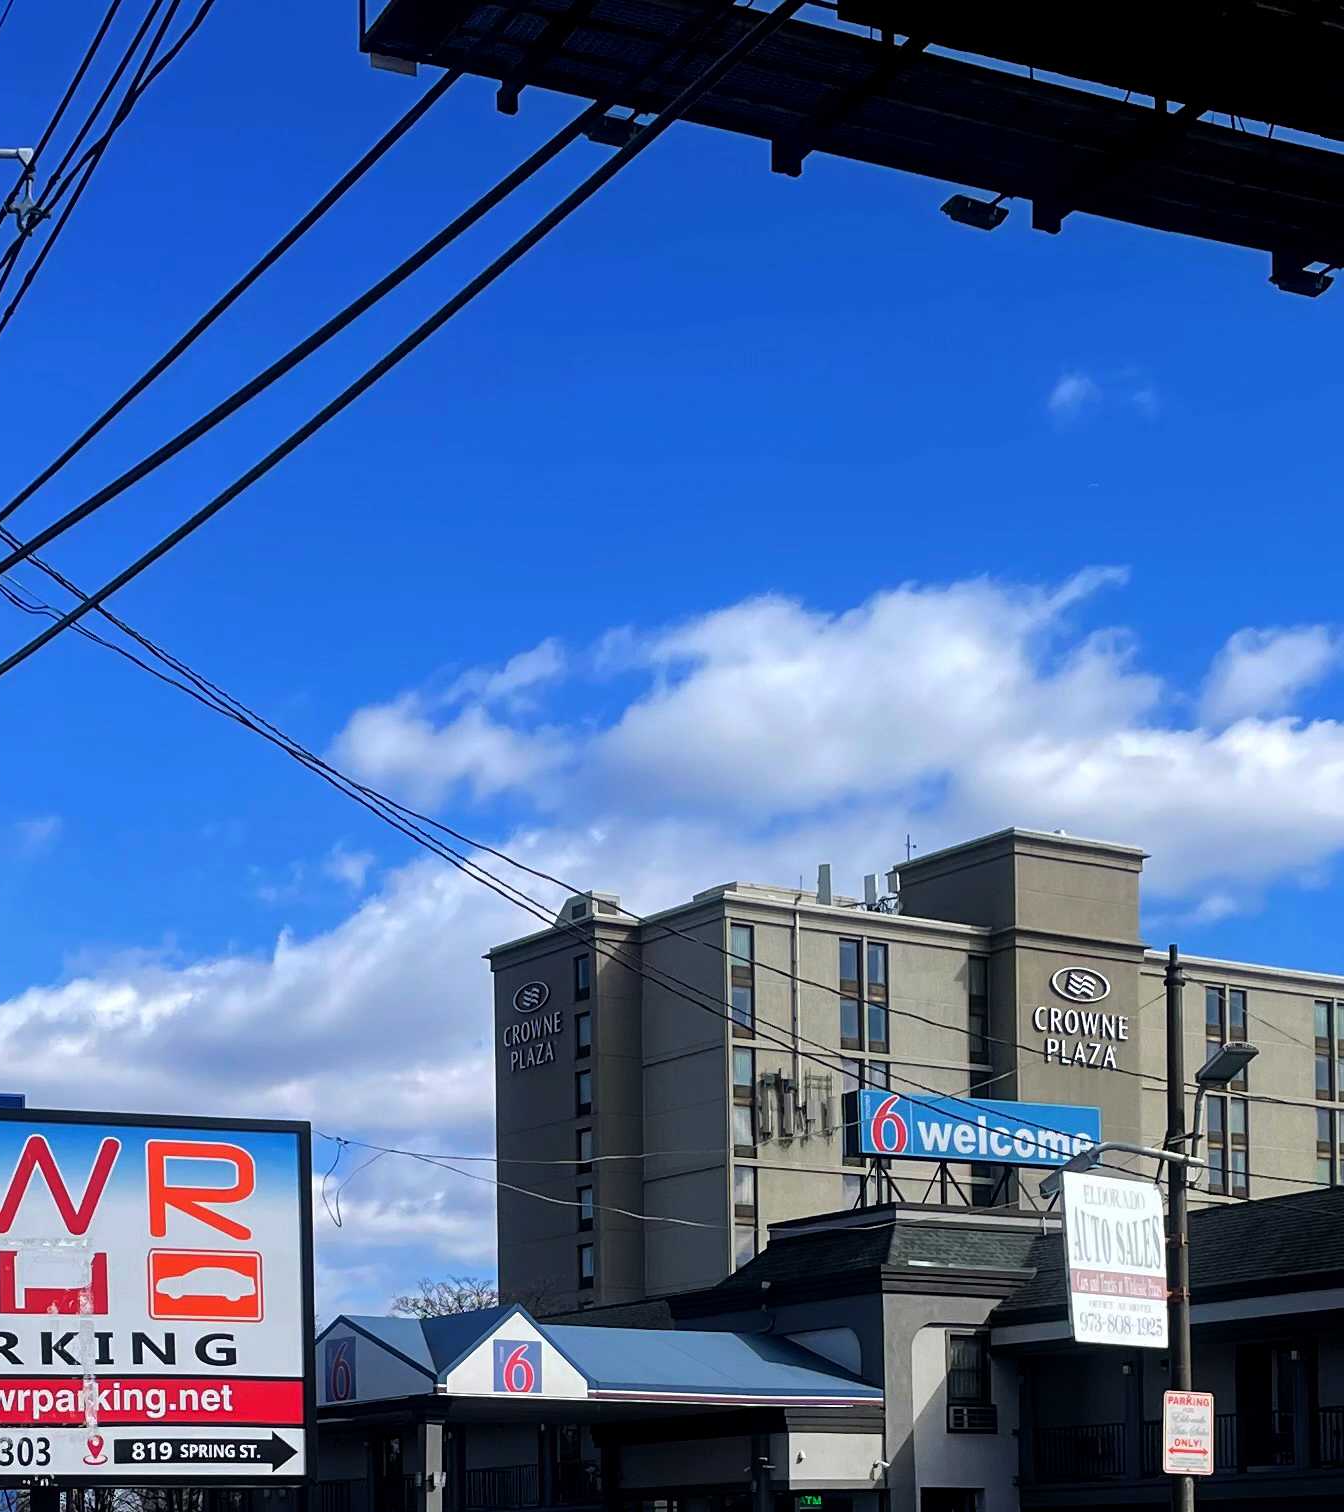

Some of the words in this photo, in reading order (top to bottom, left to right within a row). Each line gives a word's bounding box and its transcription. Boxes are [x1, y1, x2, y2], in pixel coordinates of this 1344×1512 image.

[503, 1012, 561, 1047] CROWNE
[1034, 1006, 1129, 1041] CROWNE
[510, 1041, 554, 1072] PLAZA
[1047, 1038, 1117, 1069] PLAZA
[917, 1115, 1094, 1160] welcome
[1083, 1184, 1146, 1210] ELDORADO
[1074, 1206, 1112, 1265] AUTO
[1115, 1215, 1162, 1270] SALES
[1079, 1311, 1163, 1337] 973-808-1925
[1167, 1396, 1210, 1407] PARKING
[132, 1441, 173, 1461] 819
[179, 1443, 235, 1459] SPRING
[239, 1444, 261, 1459] ST.
[1174, 1438, 1202, 1448] ONLY!
[800, 1495, 822, 1504] ATM
